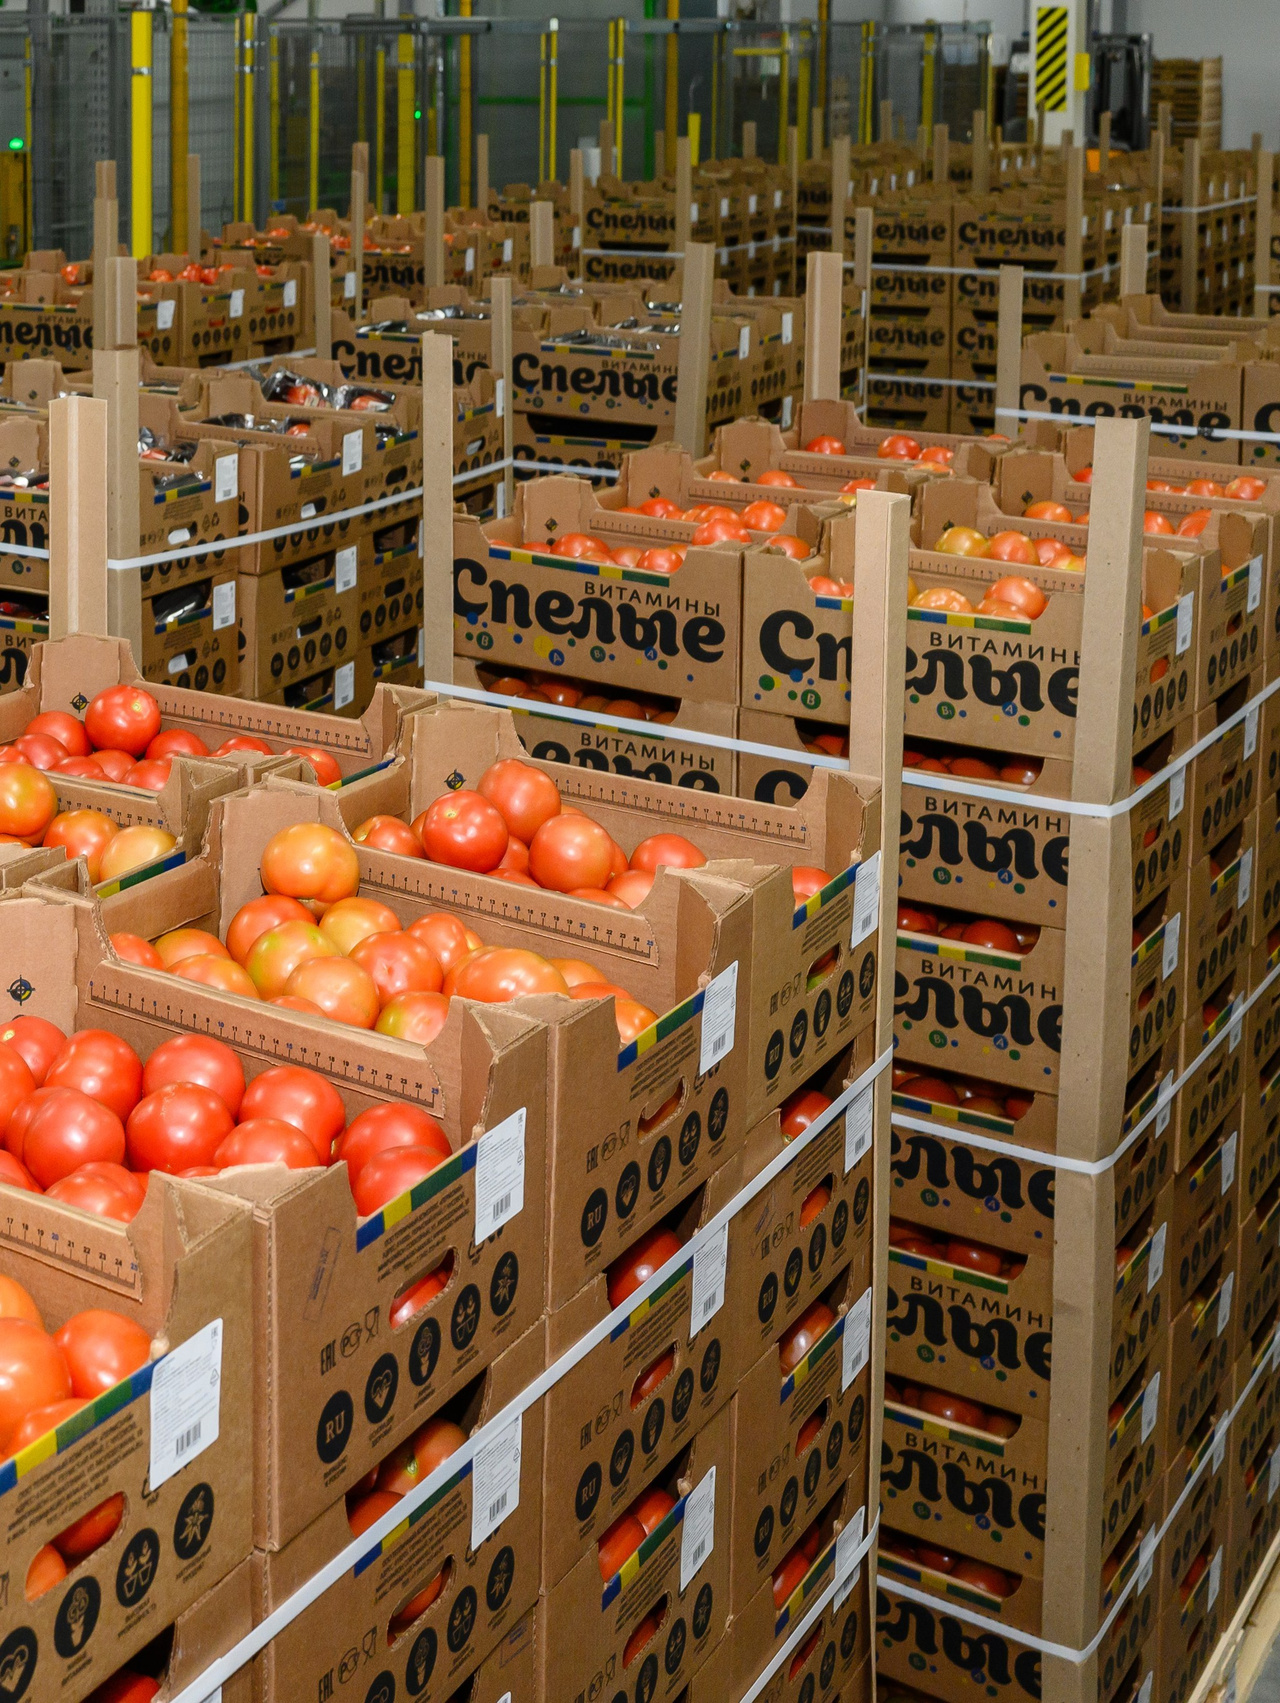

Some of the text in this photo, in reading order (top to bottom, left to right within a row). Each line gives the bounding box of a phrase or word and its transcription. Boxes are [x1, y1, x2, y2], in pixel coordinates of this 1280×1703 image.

[1124, 393, 1228, 411] ВИТАМИНЫ
[453, 558, 726, 663] Спелые
[584, 581, 720, 617] ВИТАМИНЫ
[581, 732, 715, 771] ВИТАМИНЫ
[925, 796, 1070, 833] ВИТАМИН
[922, 959, 1057, 1001] ВИТАМИН
[587, 1203, 604, 1227] RU
[911, 1275, 1053, 1329] ВИТАМИН
[325, 1410, 346, 1444] RU
[905, 1432, 1047, 1490] ВИТАМИН
[581, 1484, 597, 1508] RU
